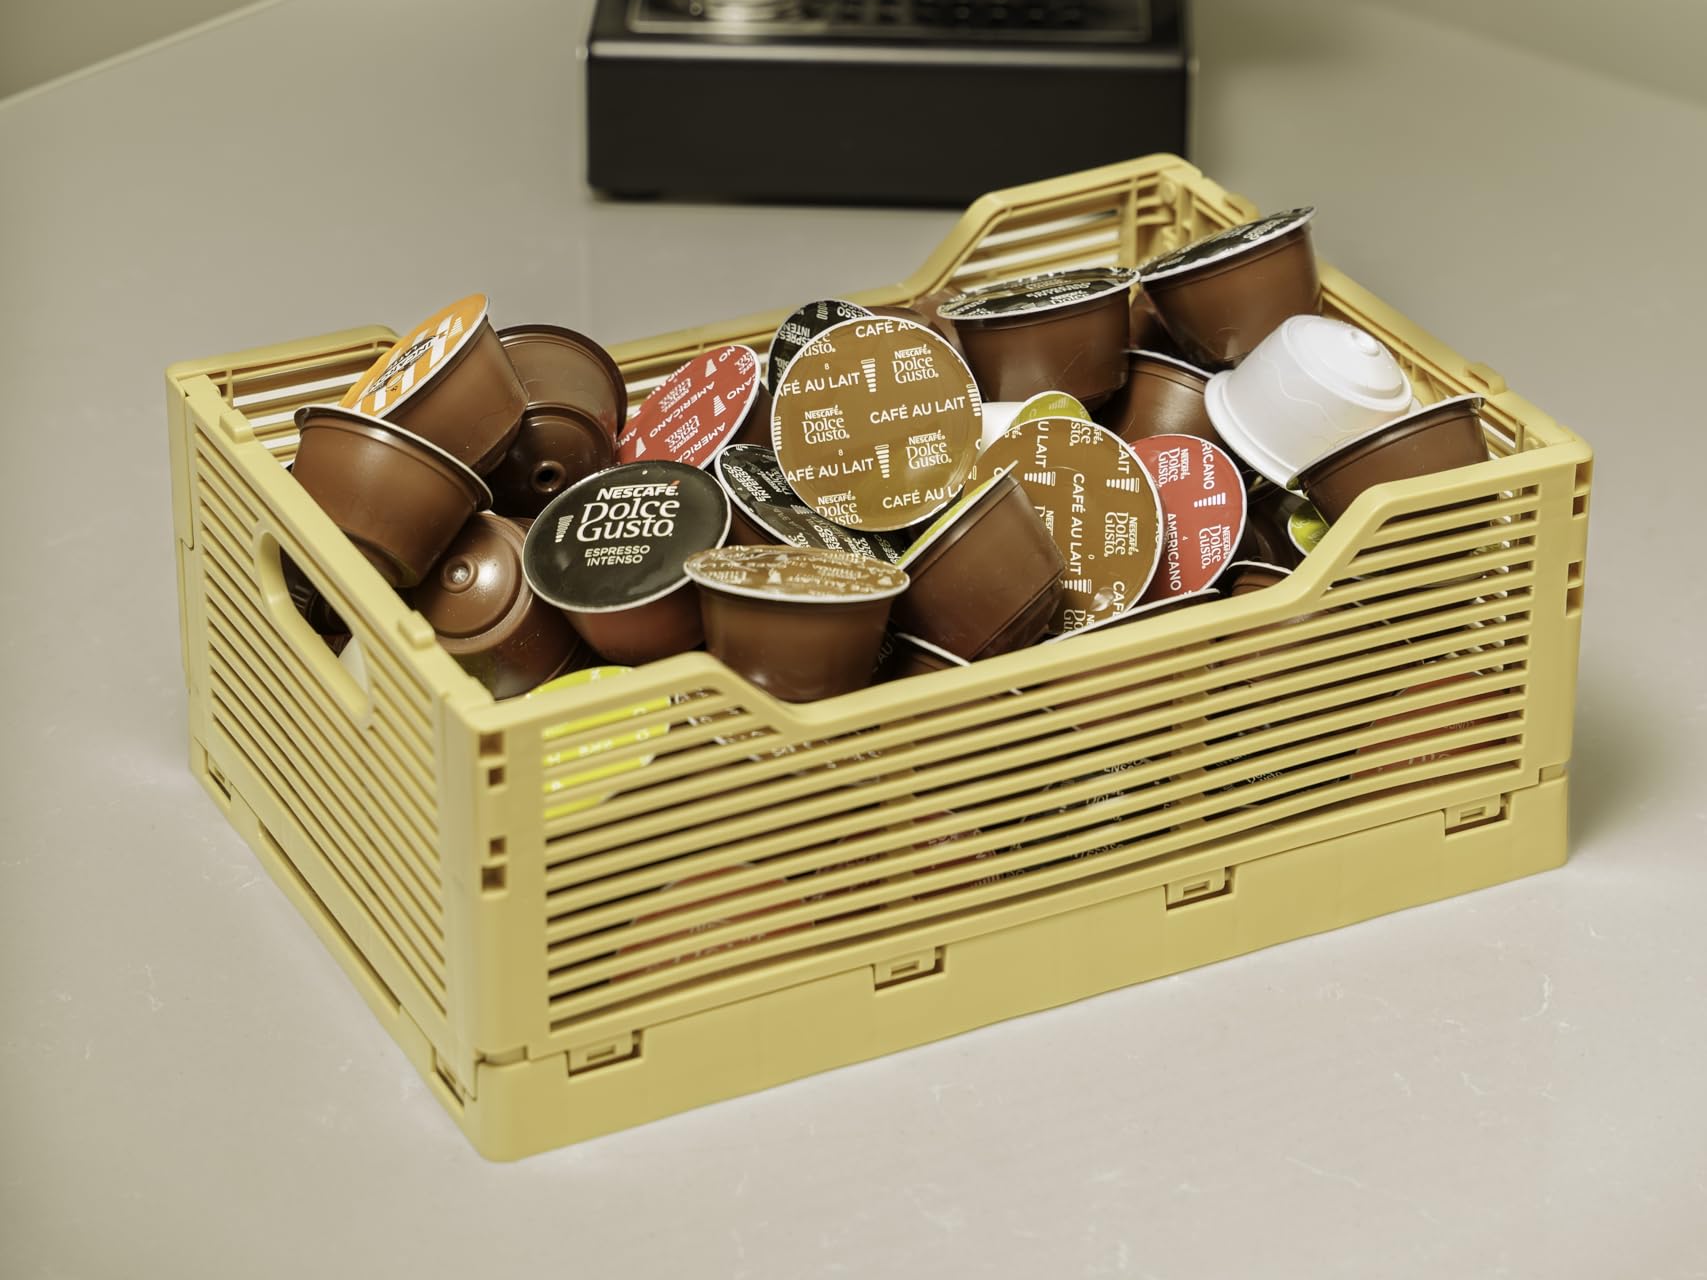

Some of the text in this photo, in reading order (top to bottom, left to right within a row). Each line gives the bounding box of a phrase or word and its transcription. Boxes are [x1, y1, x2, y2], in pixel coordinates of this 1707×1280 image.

[855, 319, 894, 338] CAFÉ
[892, 356, 934, 374] Dolce
[805, 378, 825, 393] AU
[829, 372, 860, 389] LAIT
[649, 381, 716, 438] AMERICANO
[870, 396, 965, 424] CAFÉ AU LAIT
[801, 417, 845, 435] Dolce
[905, 441, 948, 460] Dolce
[1035, 435, 1049, 468] LAIT
[818, 463, 839, 478] AU
[842, 458, 874, 475] LAIT
[1168, 447, 1181, 483] Dolce
[882, 489, 921, 509] CAFÉ
[924, 487, 944, 502] AU
[581, 498, 681, 524] Dolce
[1069, 473, 1086, 575] CAFÉ AU LAIT
[1114, 511, 1129, 556] Dolce
[584, 545, 650, 558] ESPRESSO
[1167, 513, 1182, 591] AMERICANO
[1209, 524, 1222, 563] Dolce
[587, 555, 643, 567] INTENSO
